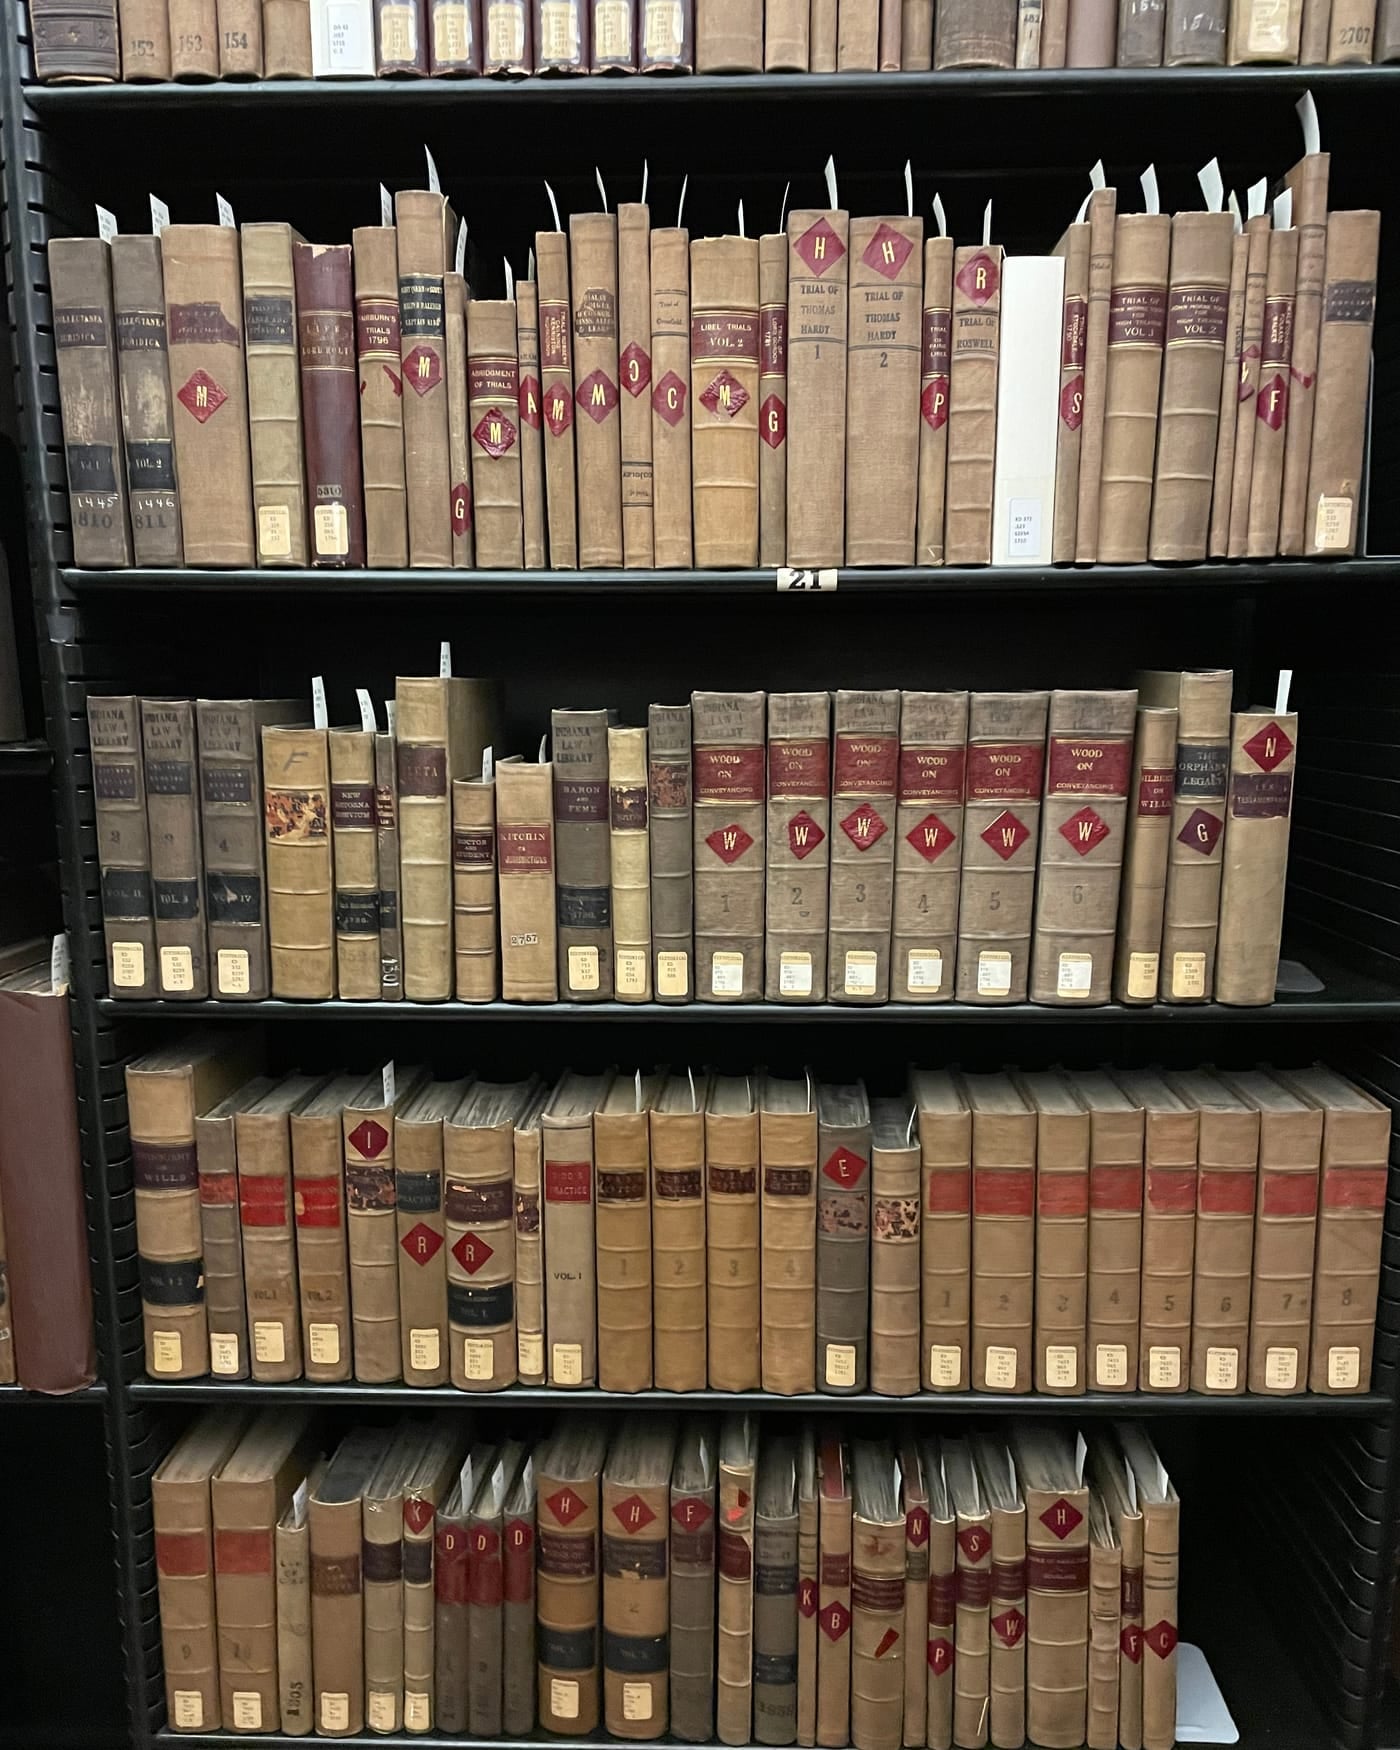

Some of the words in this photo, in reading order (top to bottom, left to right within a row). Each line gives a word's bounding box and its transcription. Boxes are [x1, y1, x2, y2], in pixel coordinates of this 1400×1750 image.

[224, 32, 248, 49] 154
[1339, 27, 1370, 45] 2707
[814, 237, 826, 259] H
[881, 241, 895, 264] H
[976, 267, 986, 290] R
[801, 285, 826, 294] TRIAL
[828, 285, 839, 294] OF
[864, 291, 890, 301] TRIAL
[892, 291, 904, 300] OF
[1121, 296, 1147, 305] TRIAL
[1182, 295, 1207, 304] TRIAL
[801, 304, 836, 314] THOMAS
[865, 313, 901, 324] THOMAS
[959, 318, 985, 327] TRIAL
[365, 327, 391, 336] TRIALS
[700, 323, 722, 331] LIBEL
[727, 323, 752, 331] TRIALS
[801, 325, 831, 334] HARDY
[1208, 326, 1217, 334] 2
[370, 336, 390, 346] 1796
[737, 338, 745, 348] 2
[867, 330, 897, 342] HARDY
[813, 345, 820, 359] 1
[879, 352, 889, 368] 2
[418, 356, 431, 378] M
[474, 382, 484, 391] OF
[486, 382, 513, 391] TRIALS
[592, 384, 606, 405] M
[196, 386, 208, 408] M
[667, 387, 677, 409] C
[720, 385, 731, 406] M
[933, 393, 945, 414] P
[1071, 392, 1082, 414] S
[1270, 390, 1280, 411] F
[527, 398, 537, 414] A
[553, 398, 564, 422] M
[768, 411, 779, 433] G
[490, 423, 502, 445] M
[77, 493, 119, 508] 1445
[138, 497, 175, 510] 1446
[454, 498, 464, 520] G
[79, 511, 114, 529] 810
[135, 515, 167, 529] 811
[789, 570, 821, 589] 21
[782, 747, 813, 756] WOOD
[850, 744, 881, 753] WOOD
[1070, 748, 1104, 758] WOOD
[1264, 738, 1276, 757] N
[710, 754, 741, 764] WOOD
[789, 761, 803, 770] ON
[856, 759, 871, 767] ON
[917, 756, 947, 766] WOOD
[989, 754, 1021, 764] WOOD
[1076, 761, 1093, 770] ON
[717, 770, 733, 779] ON
[921, 770, 937, 779] ON
[995, 767, 1011, 777] ON
[563, 786, 601, 794] BARON
[568, 804, 598, 813] FEME
[857, 817, 871, 837] W
[1078, 822, 1093, 841] W
[1196, 823, 1208, 842] G
[723, 832, 737, 851] W
[795, 826, 808, 846] W
[924, 828, 938, 847] W
[1001, 828, 1016, 847] W
[792, 888, 802, 904] 2
[855, 884, 866, 902] 3
[989, 891, 1000, 910] 5
[1072, 885, 1083, 904] 6
[720, 894, 730, 912] 1
[918, 894, 929, 912] 4
[511, 933, 538, 946] 2757
[838, 1159, 849, 1177] E
[144, 1173, 187, 1182] WILLS
[551, 1185, 588, 1195] RACTICE
[417, 1235, 427, 1254] R
[466, 1245, 475, 1262] R
[942, 1290, 951, 1308] 1
[999, 1294, 1009, 1311] 2
[1109, 1288, 1120, 1305] 4
[1164, 1294, 1176, 1312] 5
[1220, 1296, 1231, 1313] 6
[1282, 1293, 1293, 1311] 7
[1341, 1288, 1352, 1307] 8
[561, 1497, 570, 1513] H
[629, 1507, 640, 1523] H
[686, 1505, 694, 1522] F
[1057, 1509, 1066, 1526] H
[912, 1520, 921, 1535] N
[446, 1535, 455, 1550] D
[478, 1535, 486, 1551] D
[515, 1530, 523, 1546] D
[970, 1535, 980, 1552] S
[803, 1592, 811, 1606] K
[832, 1613, 840, 1629] B
[1006, 1620, 1018, 1636] W
[1130, 1635, 1137, 1652] F
[1160, 1632, 1168, 1648] C
[935, 1647, 944, 1664] P
